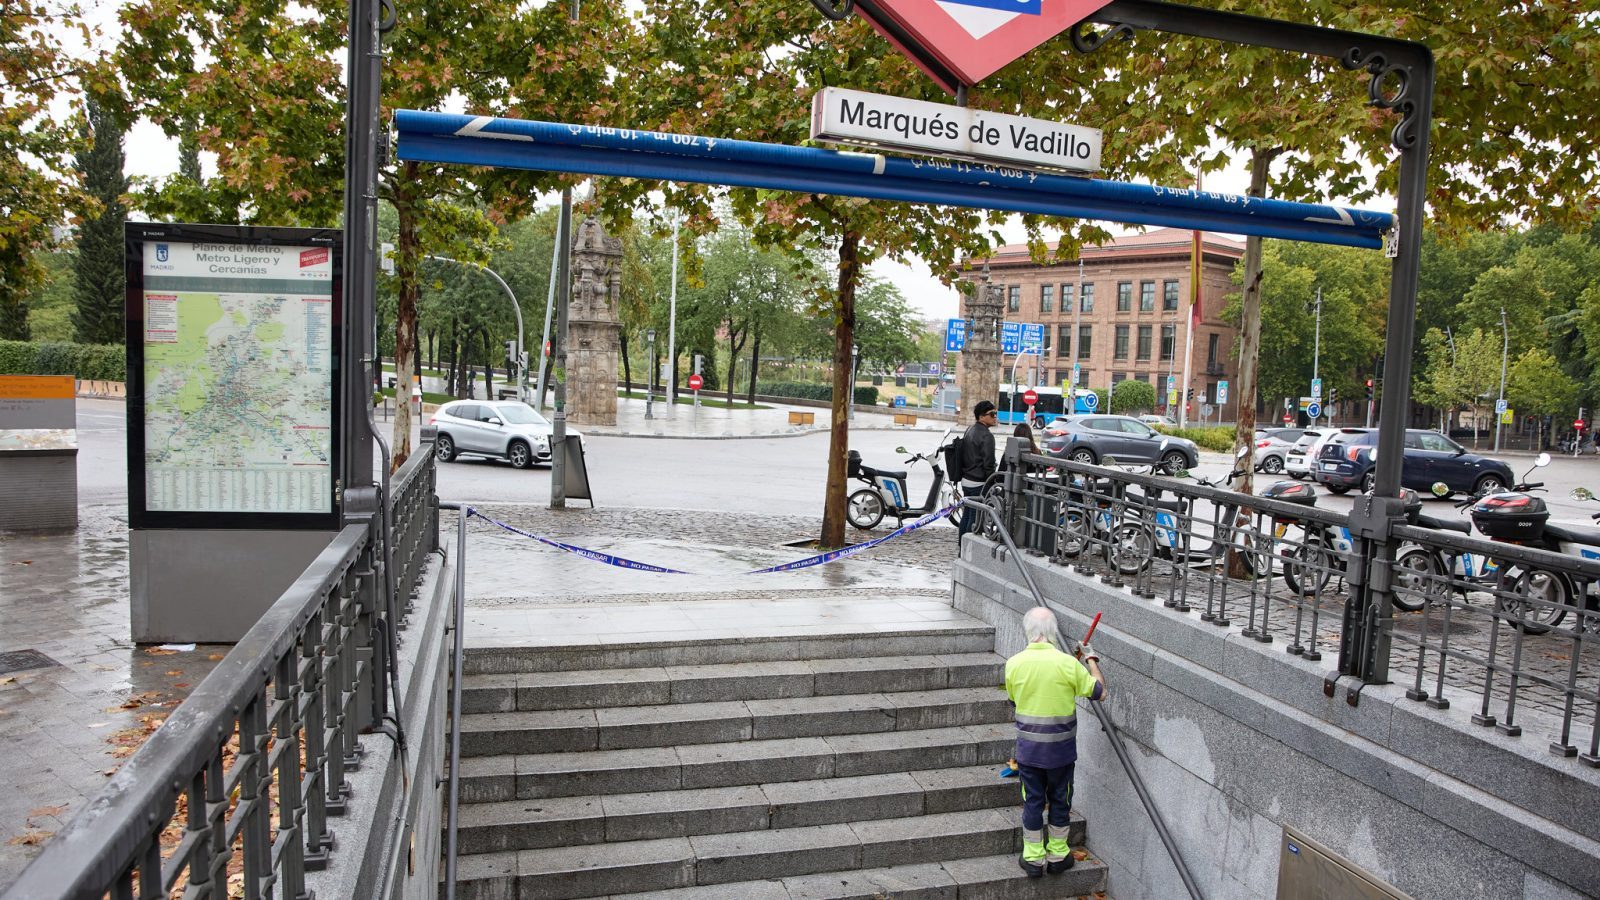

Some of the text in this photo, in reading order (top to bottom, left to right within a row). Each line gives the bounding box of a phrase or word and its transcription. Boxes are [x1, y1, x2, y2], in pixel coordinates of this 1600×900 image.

[840, 98, 1091, 160] Marqués de Vadillo
[192, 242, 285, 256] Plano de Metro,
[196, 253, 281, 266] Metro Ligero y
[588, 551, 608, 562] PASAR
[840, 550, 849, 558] NO
[801, 558, 819, 567] PASAR
